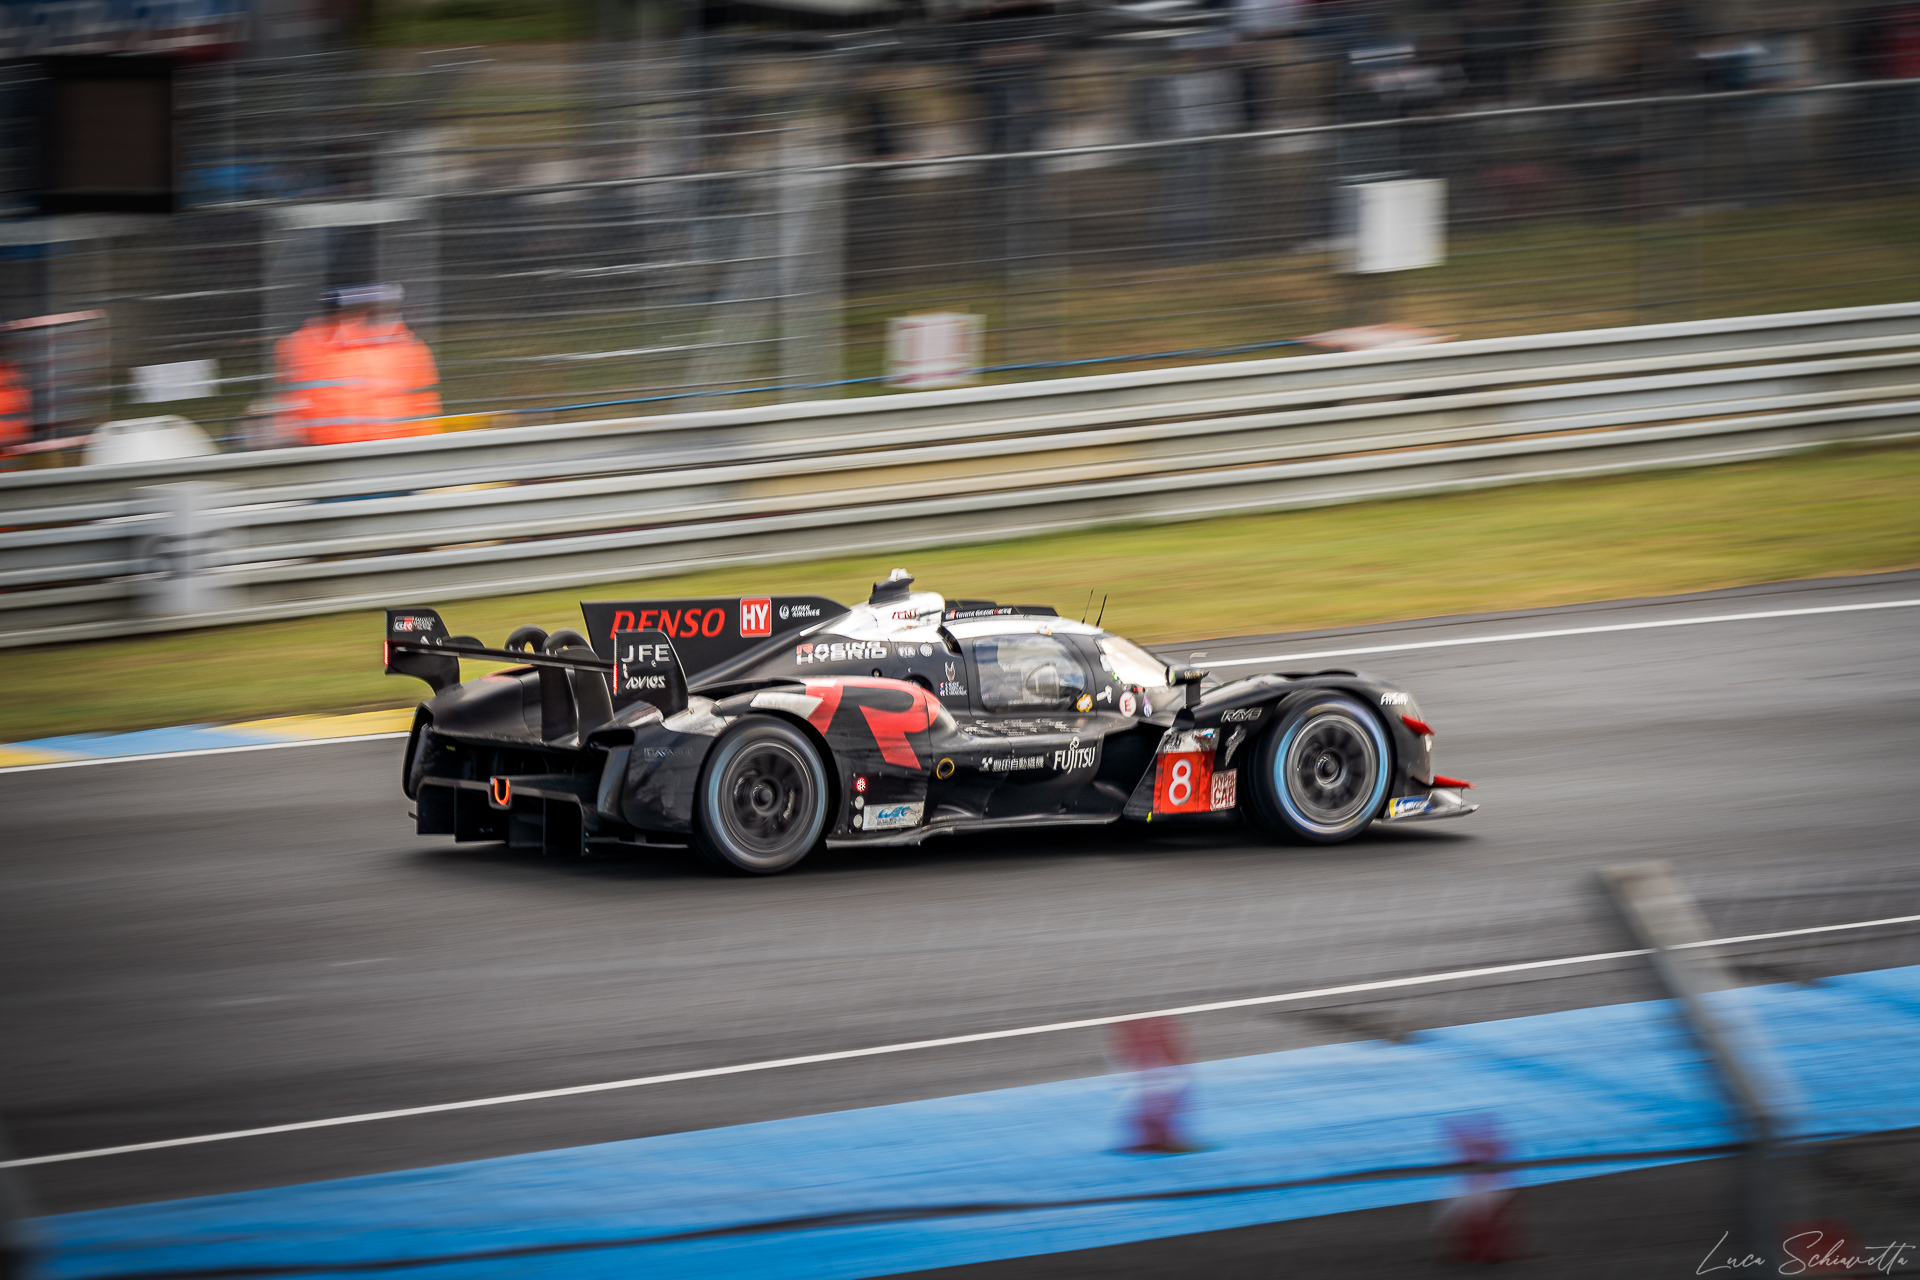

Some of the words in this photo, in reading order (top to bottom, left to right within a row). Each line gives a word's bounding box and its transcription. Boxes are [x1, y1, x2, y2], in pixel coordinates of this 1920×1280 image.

[610, 608, 725, 639] DENSO
[742, 603, 769, 630] HY
[621, 644, 670, 662] JFE
[796, 647, 887, 665] HYBRID
[797, 642, 880, 655] RACING
[1053, 746, 1096, 775] FUJITSU
[1168, 758, 1192, 806] 8
[1213, 786, 1234, 805] CAR
